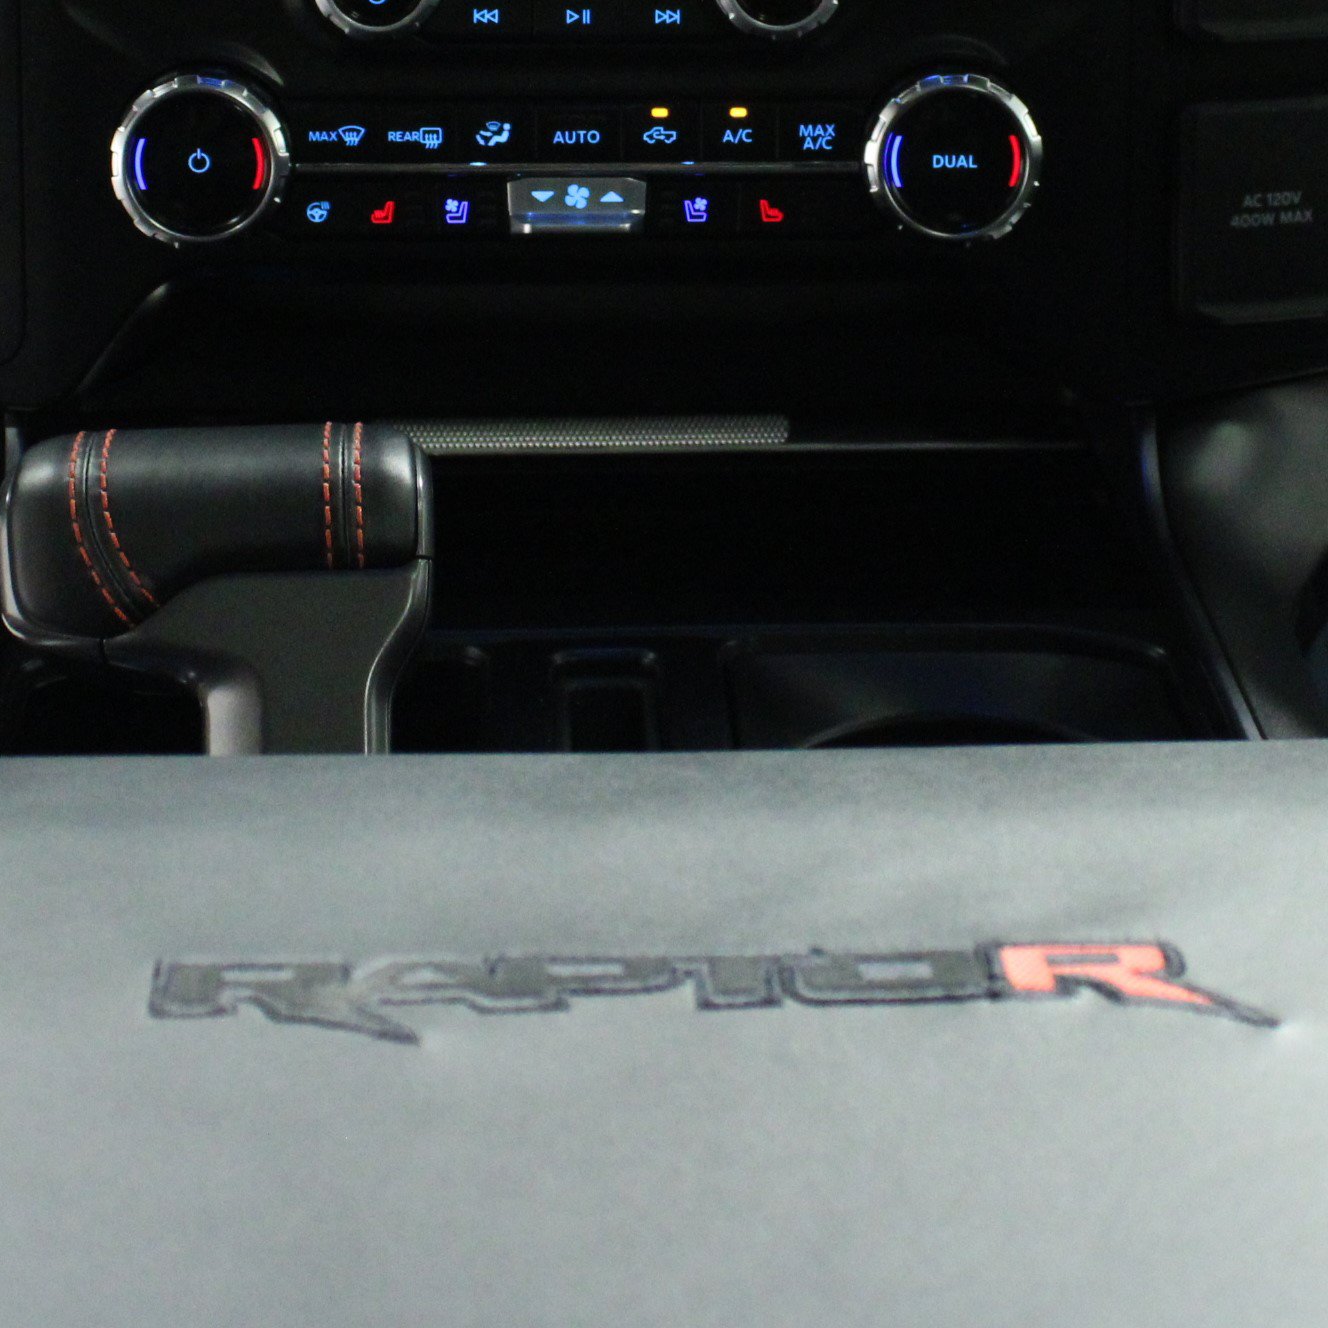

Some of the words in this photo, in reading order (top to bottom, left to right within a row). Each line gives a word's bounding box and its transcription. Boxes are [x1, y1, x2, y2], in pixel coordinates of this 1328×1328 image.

[309, 131, 337, 142] MAX
[388, 131, 419, 142] REAR
[553, 130, 600, 144] AUTO
[723, 129, 753, 144] A/C
[799, 124, 836, 137] MAX
[802, 137, 833, 151] A/C
[932, 154, 978, 168] DUAL
